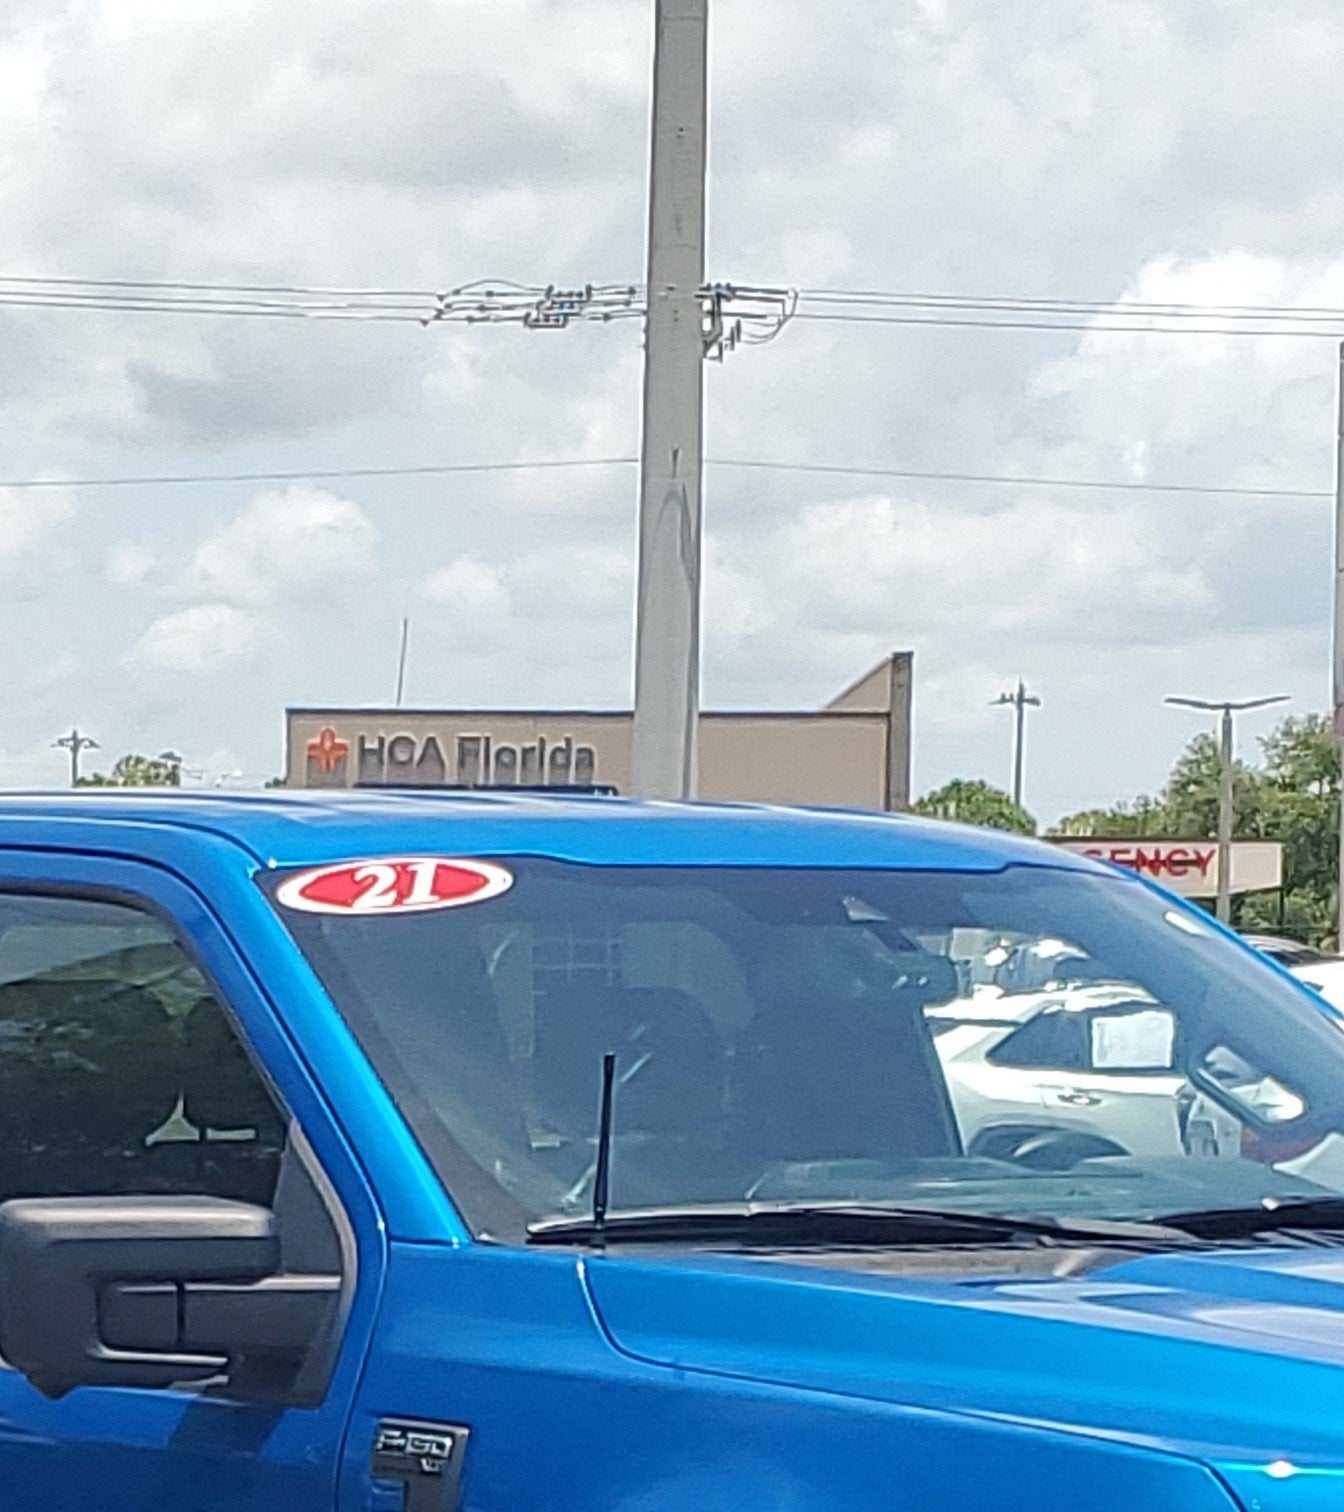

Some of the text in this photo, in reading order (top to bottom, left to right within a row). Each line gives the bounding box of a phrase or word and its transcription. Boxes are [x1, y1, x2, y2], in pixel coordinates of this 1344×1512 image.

[357, 733, 596, 774] HCA Florida
[352, 861, 440, 908] 21
